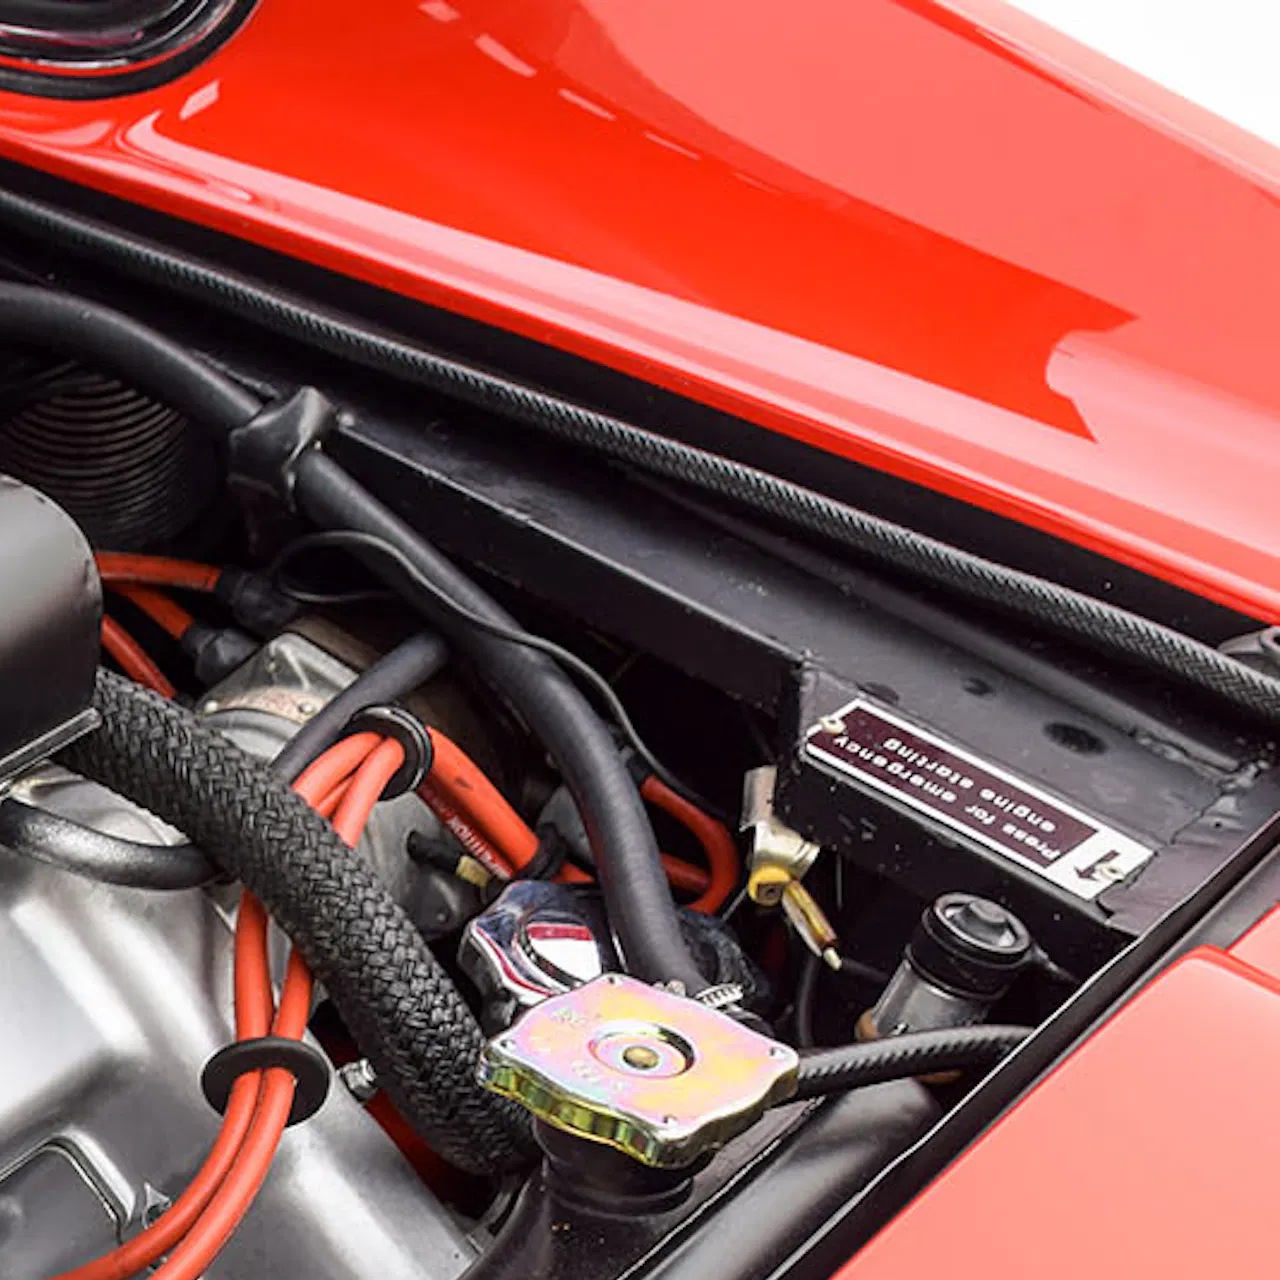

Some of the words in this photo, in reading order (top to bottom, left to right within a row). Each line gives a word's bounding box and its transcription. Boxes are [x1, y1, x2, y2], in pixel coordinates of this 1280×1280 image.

[833, 734, 957, 803] emergency
[883, 737, 974, 790] starting
[965, 804, 996, 826] for
[980, 788, 1056, 833] engine
[1002, 823, 1061, 861] Press
